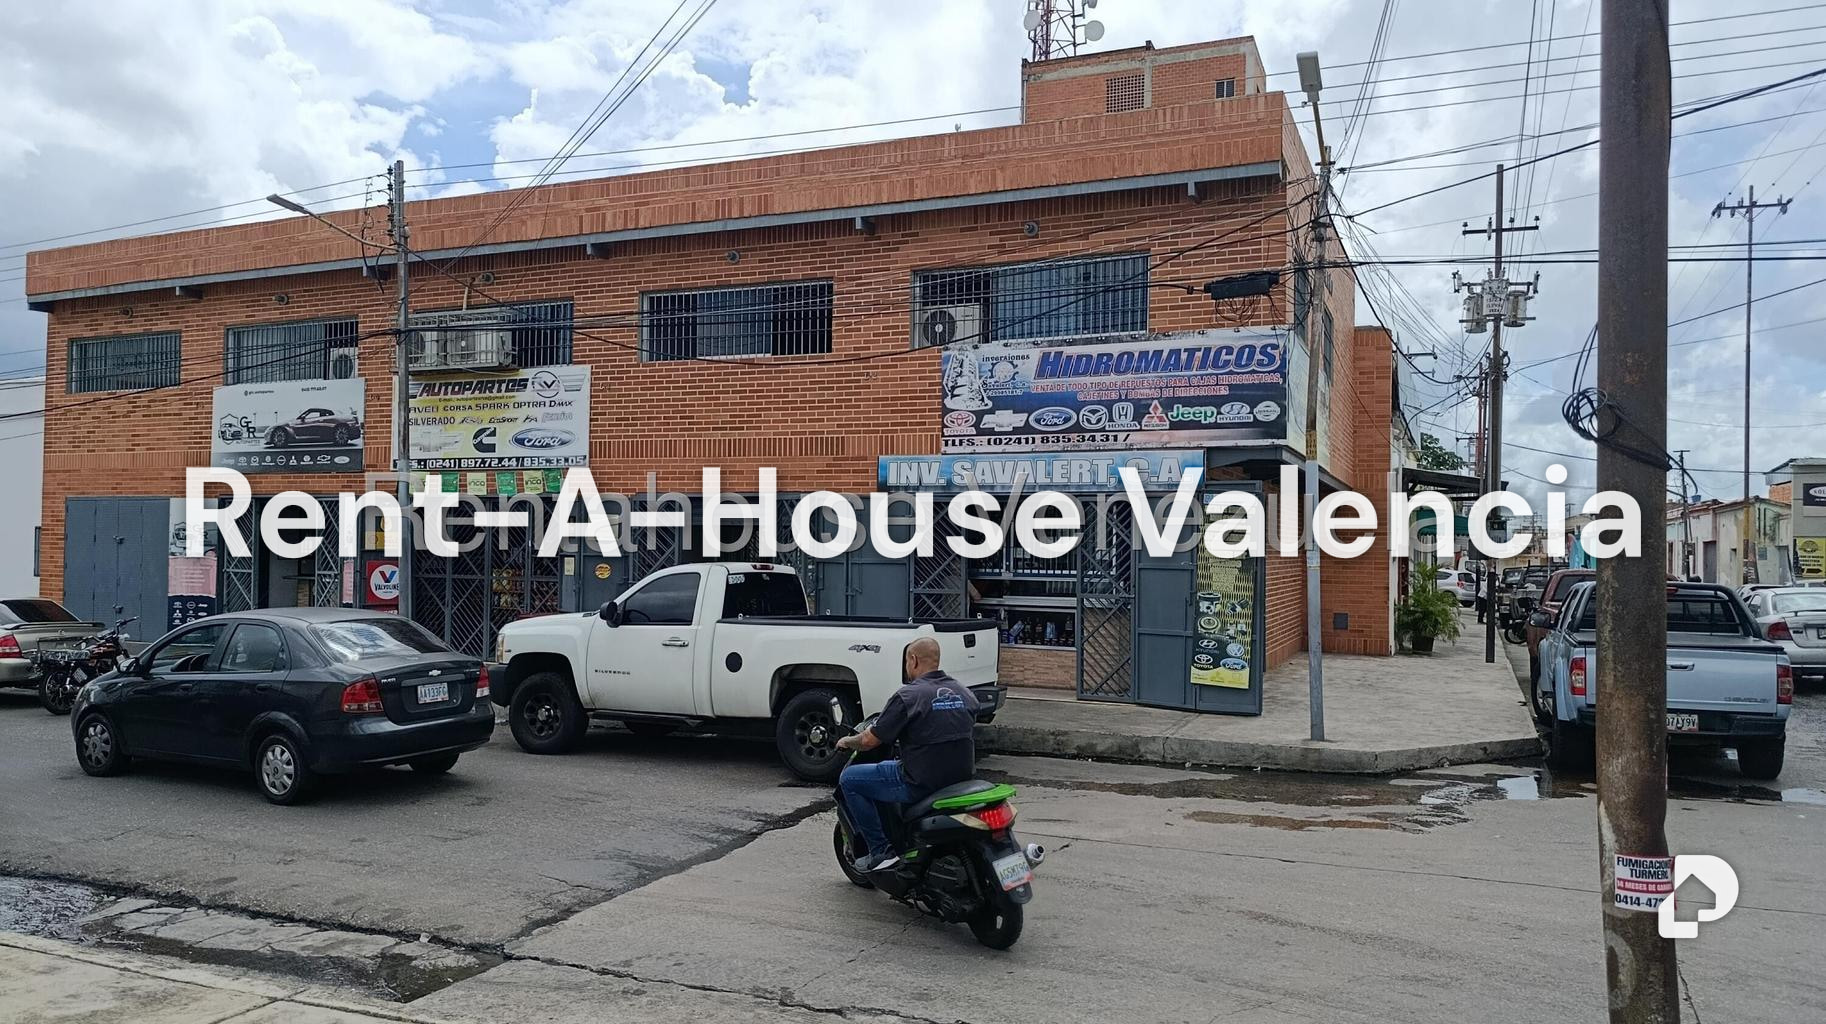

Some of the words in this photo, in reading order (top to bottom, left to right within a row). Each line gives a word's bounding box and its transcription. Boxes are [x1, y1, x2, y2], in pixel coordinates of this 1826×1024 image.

[982, 354, 1030, 362] inversiones
[1034, 343, 1280, 380] HIDROMATICOS
[1054, 383, 1066, 391] DE
[1068, 382, 1088, 391] TODO
[1090, 381, 1107, 390] TIPO
[1109, 380, 1120, 388] DE
[1121, 378, 1167, 388] REPUESTOS
[1168, 377, 1189, 386] PARA
[1191, 375, 1217, 385] CAJAS
[1077, 390, 1119, 401] CAJETINES
[1128, 388, 1160, 399] BOMBAS
[1162, 388, 1173, 397] DE
[1175, 385, 1229, 396] DIRECCIONES
[475, 402, 510, 411] SPARK
[513, 400, 546, 409] OPTRA
[1041, 412, 1065, 426] Ford
[1170, 405, 1215, 422] Jeep
[408, 416, 456, 426] SILVERADO
[525, 434, 561, 447] Ford
[1041, 434, 1118, 444] 835.34.31
[427, 459, 458, 470] (0241)
[461, 458, 517, 469] 897.72.44
[524, 455, 585, 467] 835.33.05
[887, 460, 947, 486] INV.
[951, 458, 1118, 487] SAVALERT,
[1125, 457, 1194, 485] C.A.
